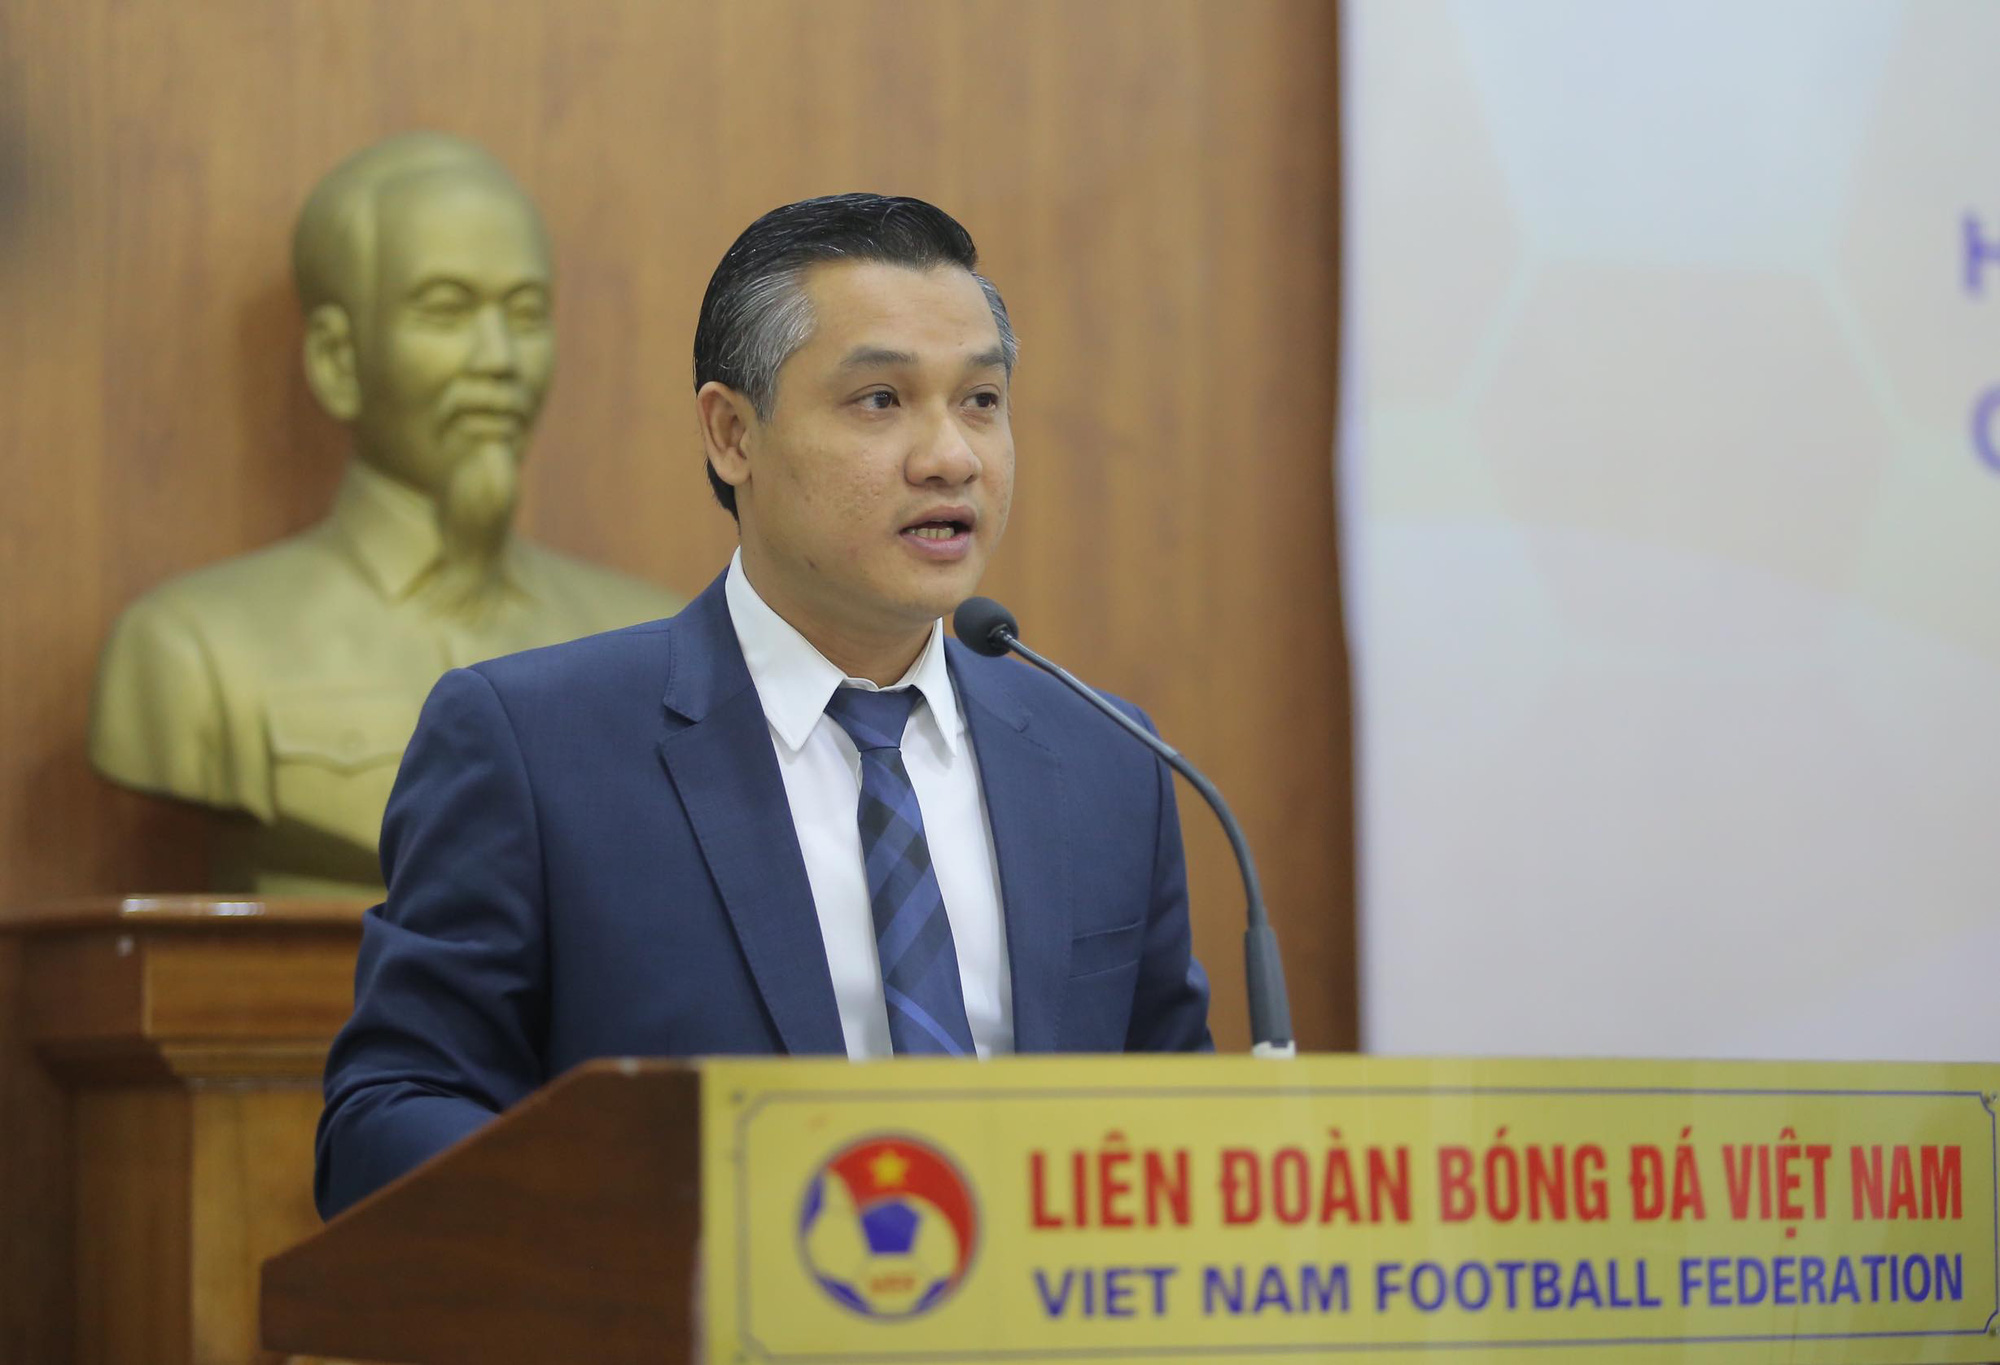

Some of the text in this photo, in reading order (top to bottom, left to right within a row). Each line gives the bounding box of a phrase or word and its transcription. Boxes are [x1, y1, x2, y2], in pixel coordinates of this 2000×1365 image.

[1029, 1125, 1963, 1240] LIÊN ĐOÀN BÓNG ĐÁ VIỆT NAM
[1033, 1252, 1964, 1318] VIET NAM FOOTBALL FEDERATION
